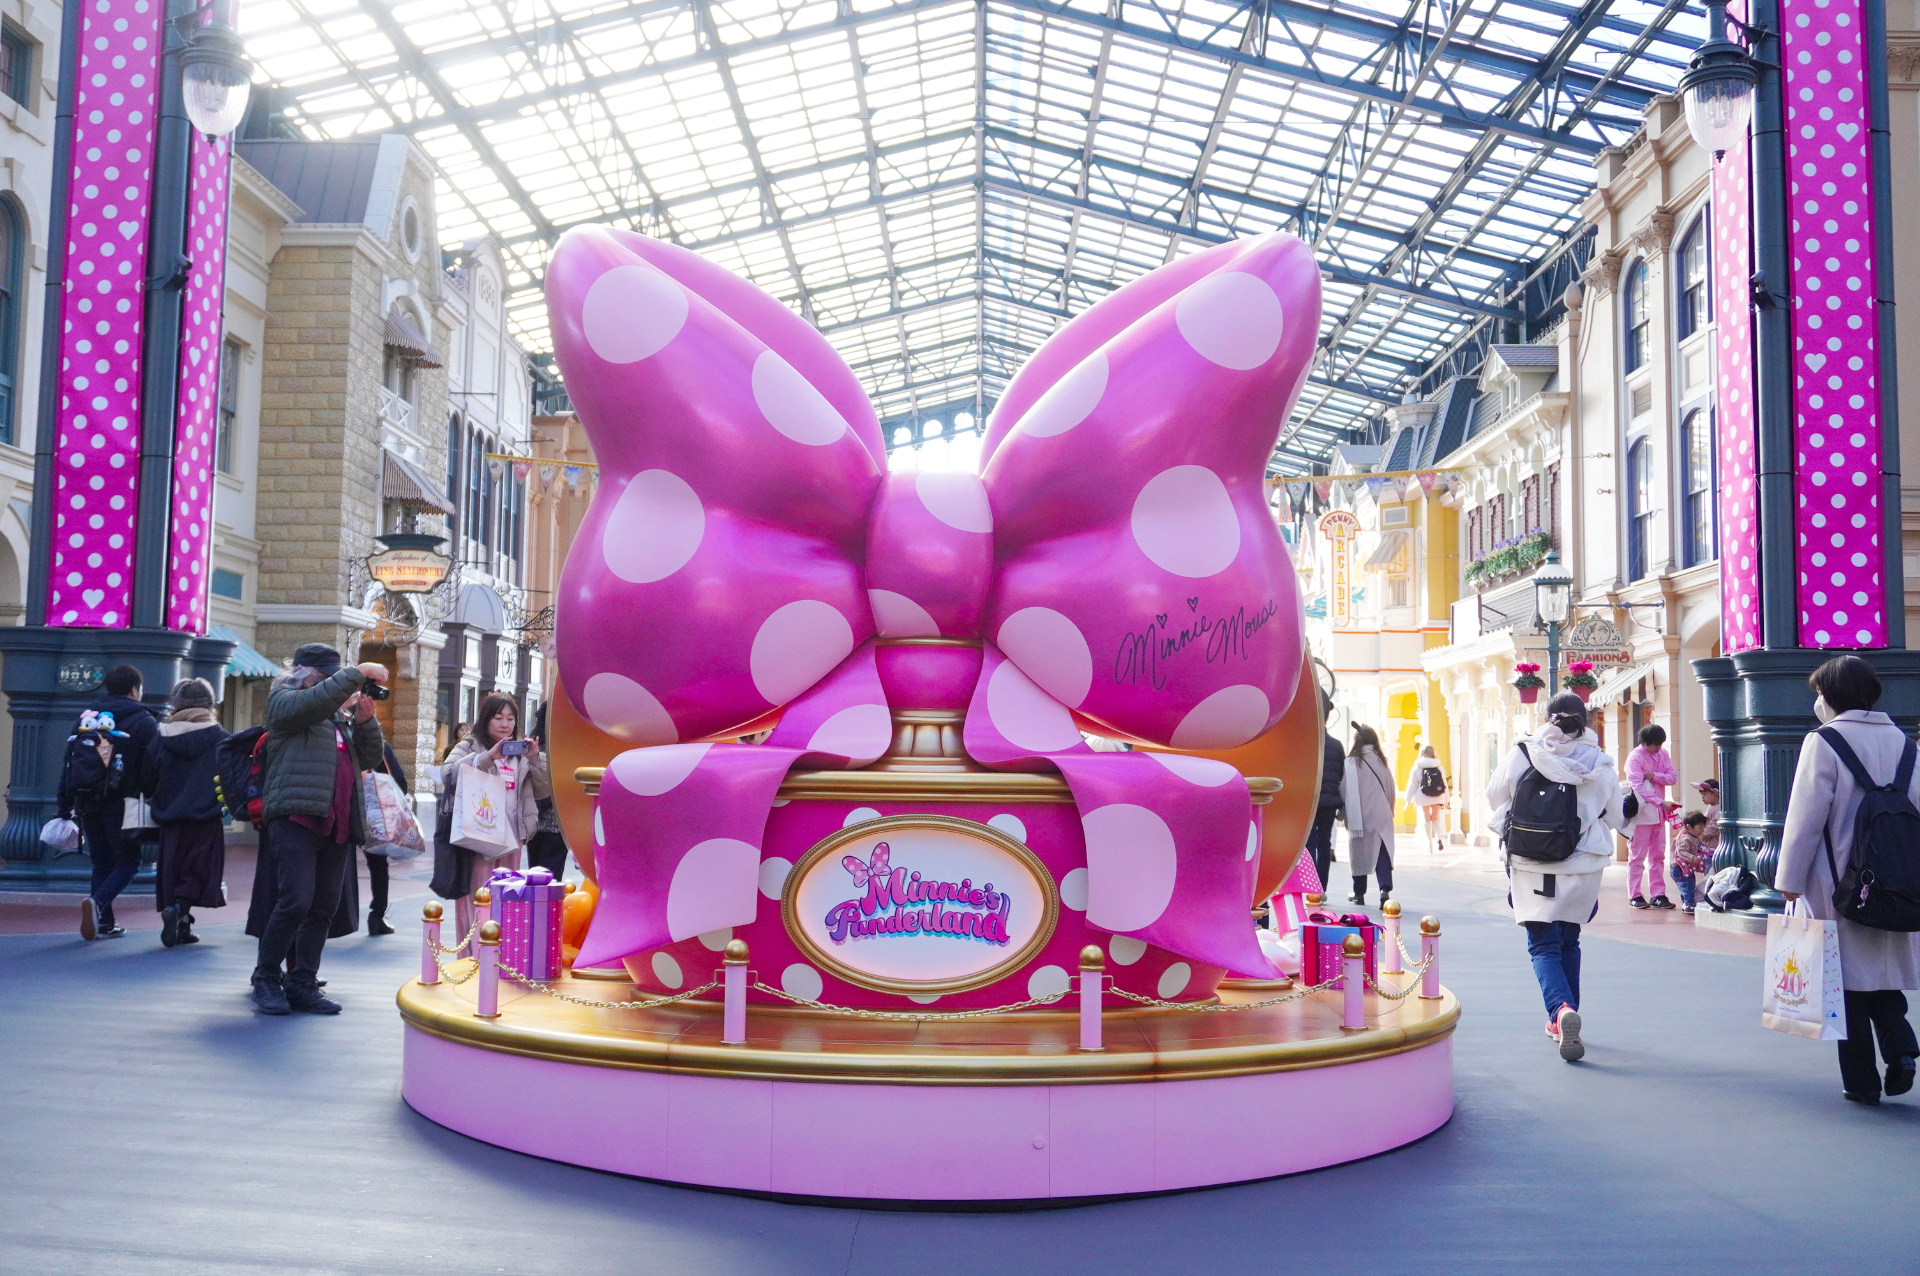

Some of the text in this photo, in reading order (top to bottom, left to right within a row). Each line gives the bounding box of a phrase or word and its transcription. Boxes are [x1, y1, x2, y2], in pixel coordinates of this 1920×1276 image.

[1326, 514, 1355, 526] PENNY
[1336, 523, 1345, 616] ARCADE
[1115, 597, 1278, 690] Minnie Mouse
[1566, 651, 1630, 664] FASHIONS
[860, 866, 1001, 918] Minnie's
[825, 892, 1011, 946] Funderland
[1777, 970, 1802, 998] 40
